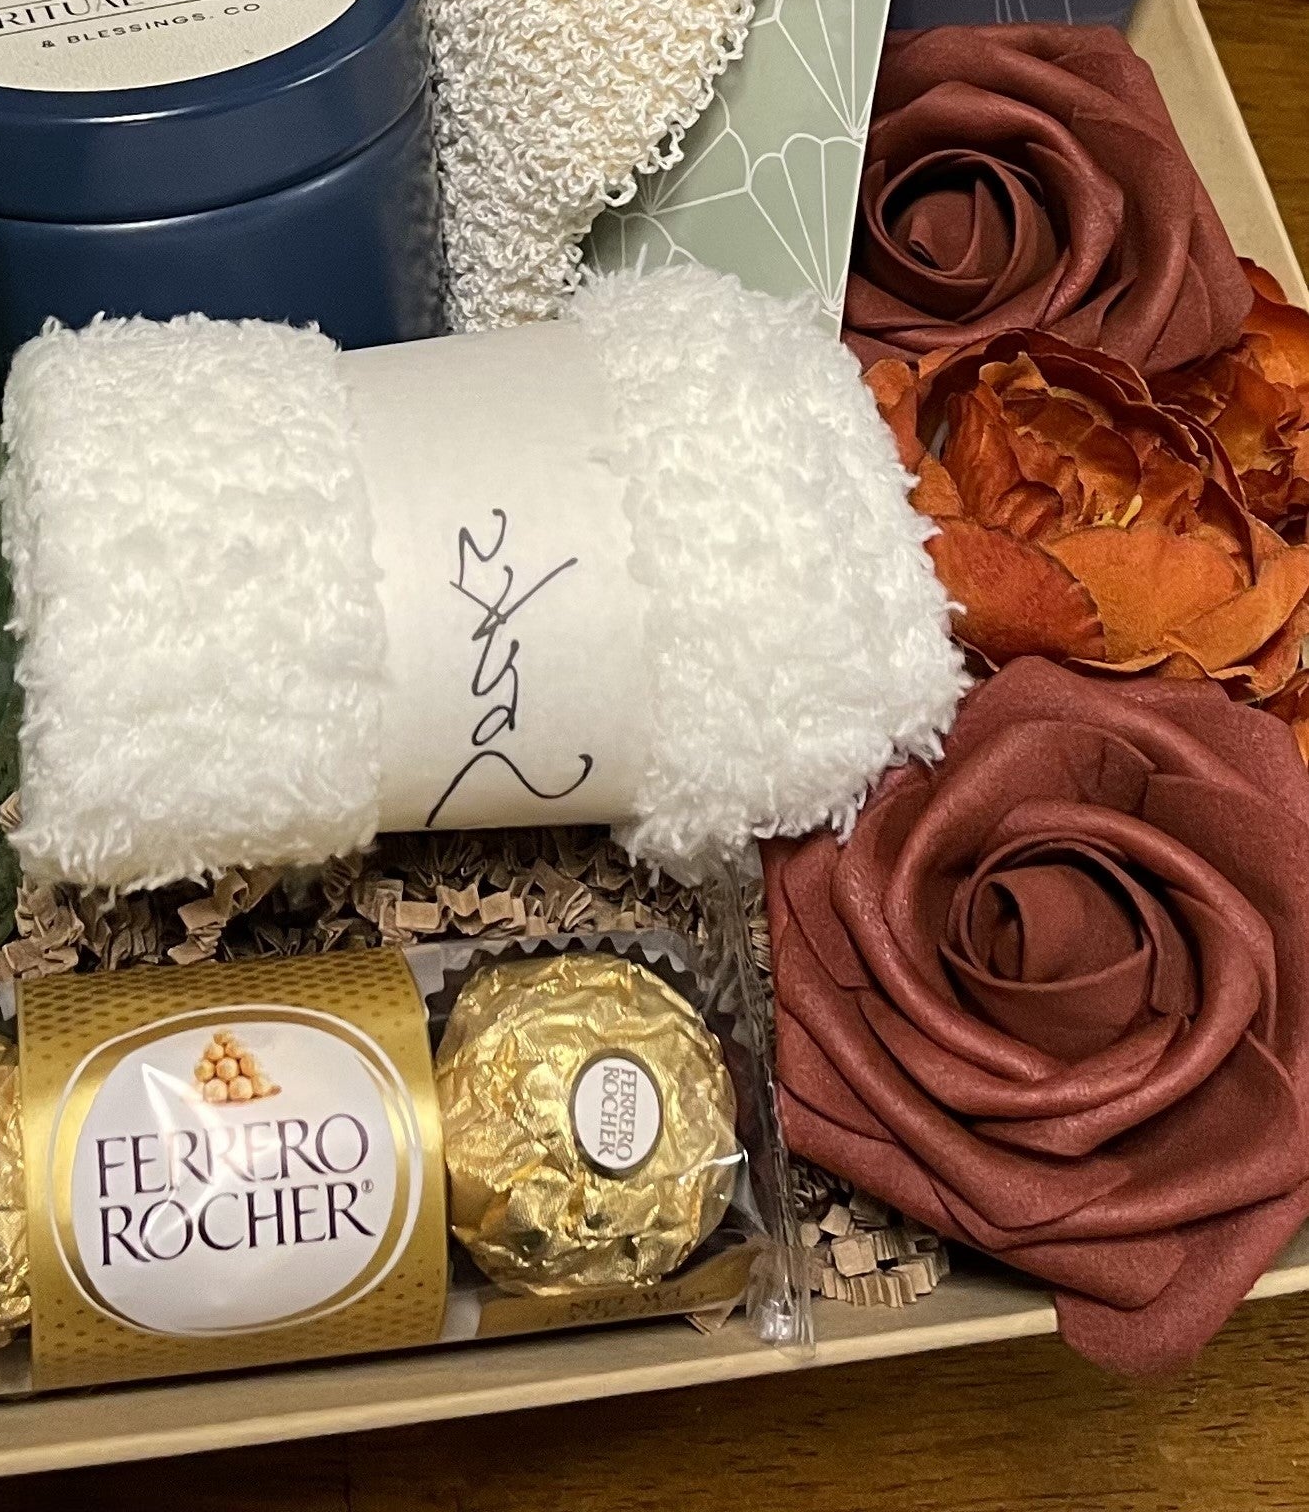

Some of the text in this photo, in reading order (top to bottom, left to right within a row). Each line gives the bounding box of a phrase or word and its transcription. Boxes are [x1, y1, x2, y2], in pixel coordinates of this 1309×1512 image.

[42, 39, 56, 49] &
[224, 2, 261, 16] CO
[95, 1113, 369, 1198] FERRERO
[597, 1066, 620, 1157] ROCHER
[616, 1068, 637, 1161] FERRERO
